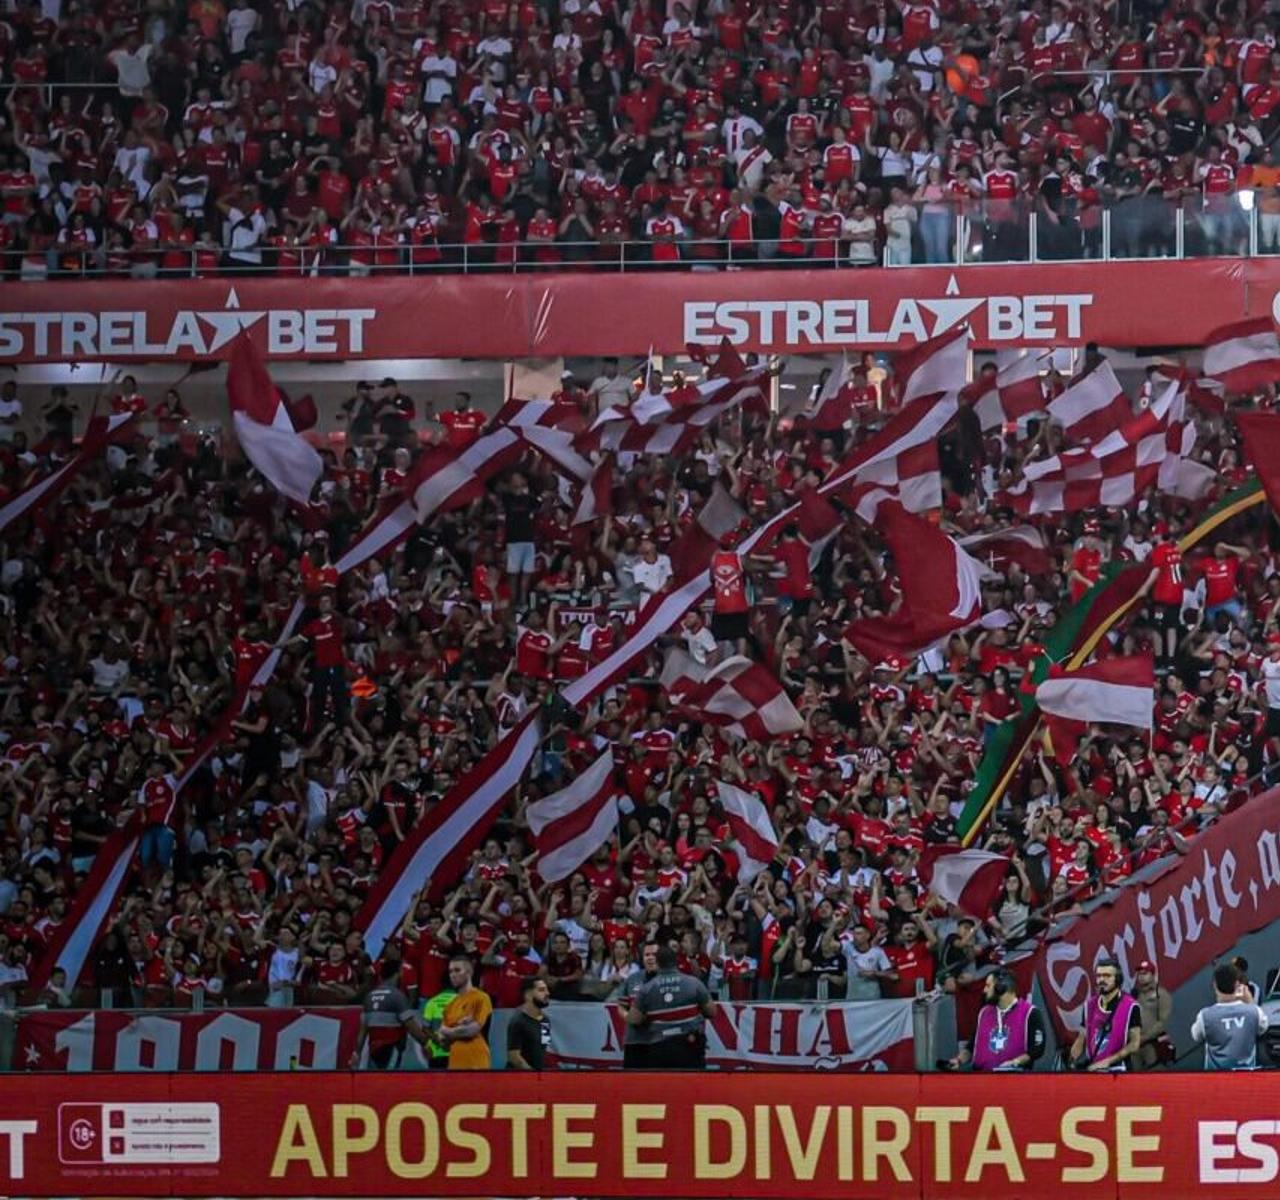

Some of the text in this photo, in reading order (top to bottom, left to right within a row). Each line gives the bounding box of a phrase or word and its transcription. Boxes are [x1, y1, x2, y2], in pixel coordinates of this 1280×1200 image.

[1221, 1016, 1246, 1031] TV
[270, 1102, 597, 1178] APOSTE
[622, 1104, 667, 1178] E
[694, 1104, 1164, 1183] DIVIRTA-SE
